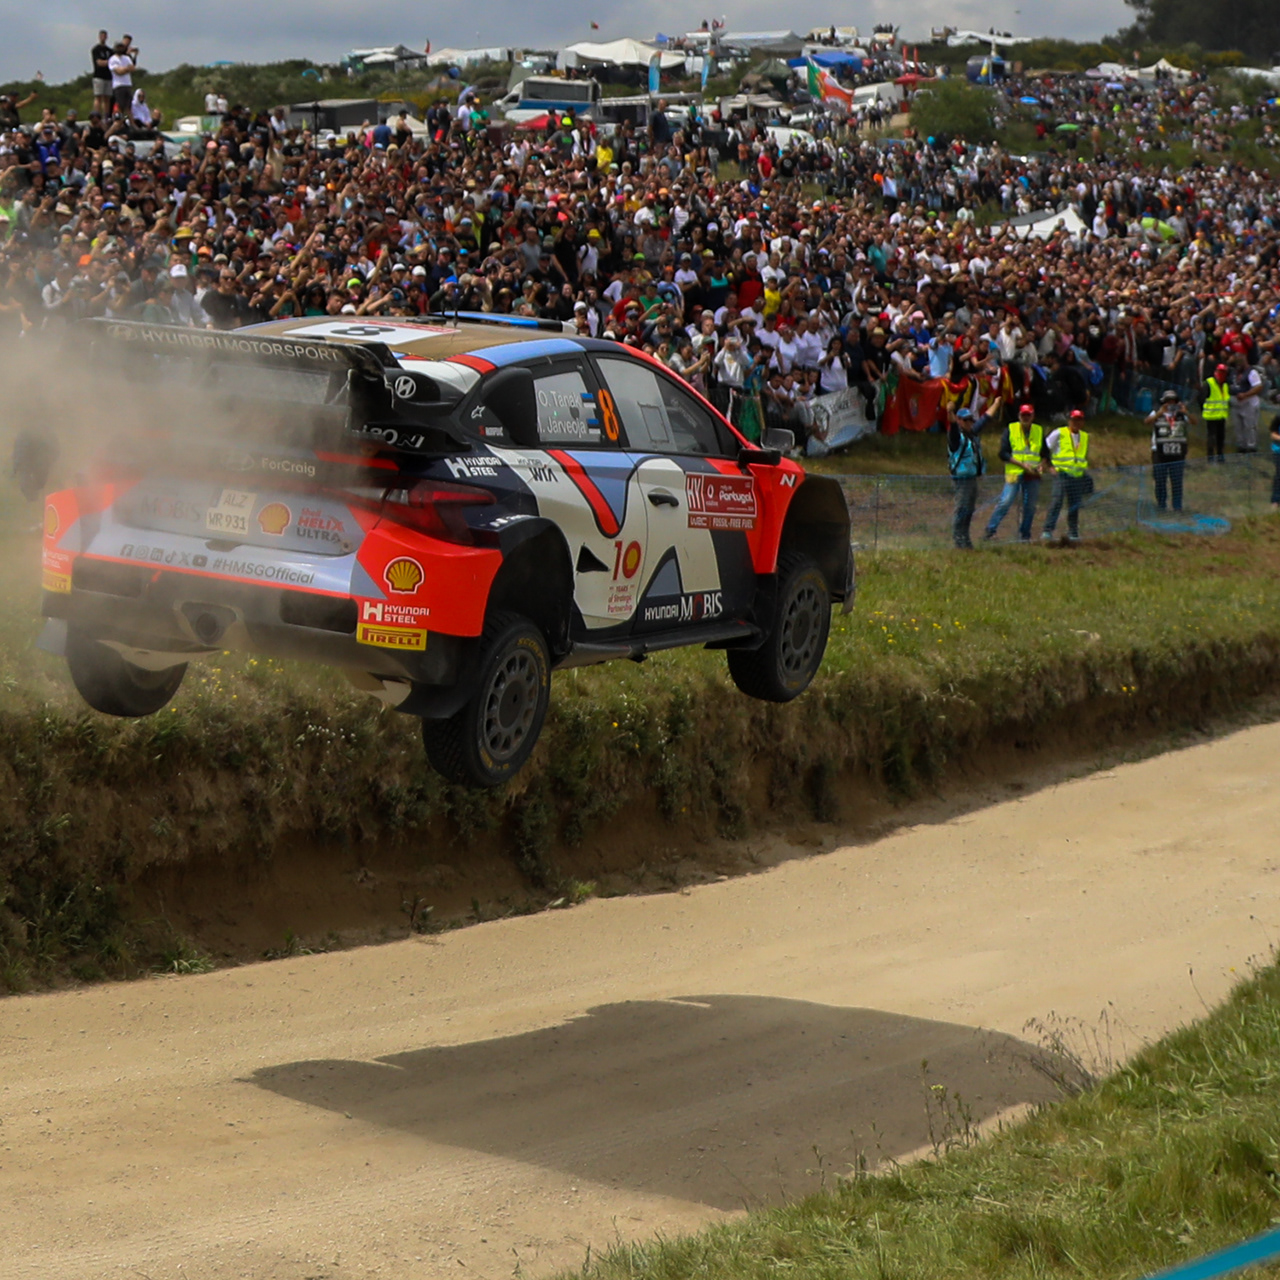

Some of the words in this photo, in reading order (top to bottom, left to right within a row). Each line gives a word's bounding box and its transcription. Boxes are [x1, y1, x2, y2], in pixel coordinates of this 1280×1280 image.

[141, 329, 222, 351] HYUNDAI
[228, 337, 340, 362] MOTORSPORT
[598, 388, 619, 441] 8
[261, 457, 316, 477] ForCraig
[463, 457, 502, 466] HYUNDAI
[470, 467, 498, 476] STEEL
[225, 514, 246, 530] 931
[297, 515, 345, 532] HELIX
[296, 527, 342, 544] ULTRA
[212, 558, 315, 585] #HMSGOfficial
[384, 604, 430, 616] HYUNDAI
[645, 604, 679, 620] HYUNDAI
[679, 592, 723, 621] MOBIS
[384, 613, 417, 624] STEEL
[362, 627, 421, 646] PIRELLI
